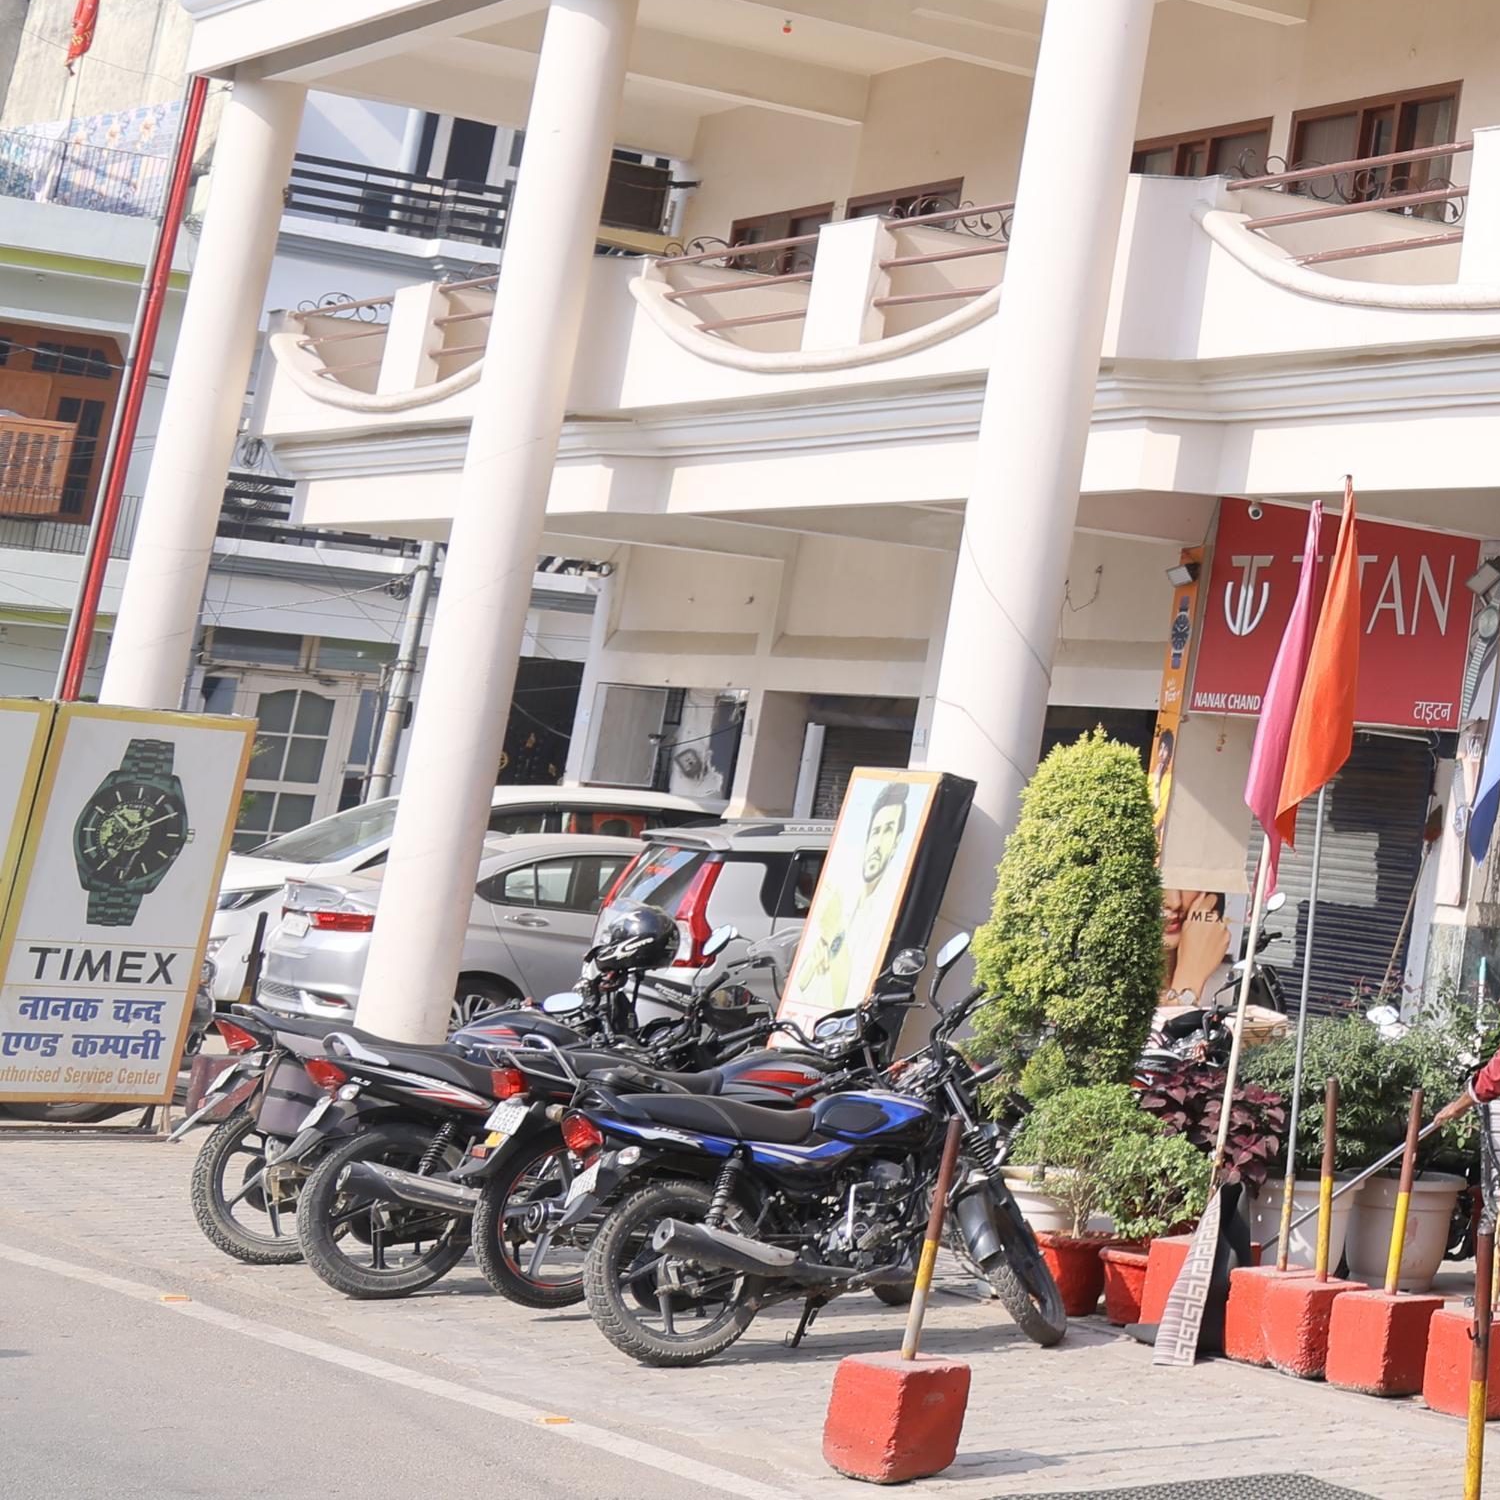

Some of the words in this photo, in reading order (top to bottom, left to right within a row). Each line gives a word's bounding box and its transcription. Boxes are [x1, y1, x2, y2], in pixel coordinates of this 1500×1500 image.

[1194, 692, 1227, 709] NANAK
[1228, 693, 1261, 711] CHAND
[1413, 701, 1453, 724] टाइटन
[29, 946, 178, 985] TIMEX
[19, 995, 104, 1022] नानक
[112, 998, 167, 1024] चन्द
[1, 1031, 64, 1058] एण्ड
[71, 1028, 166, 1060] कम्पनी
[64, 1066, 114, 1084] Service
[117, 1067, 161, 1085] Center
